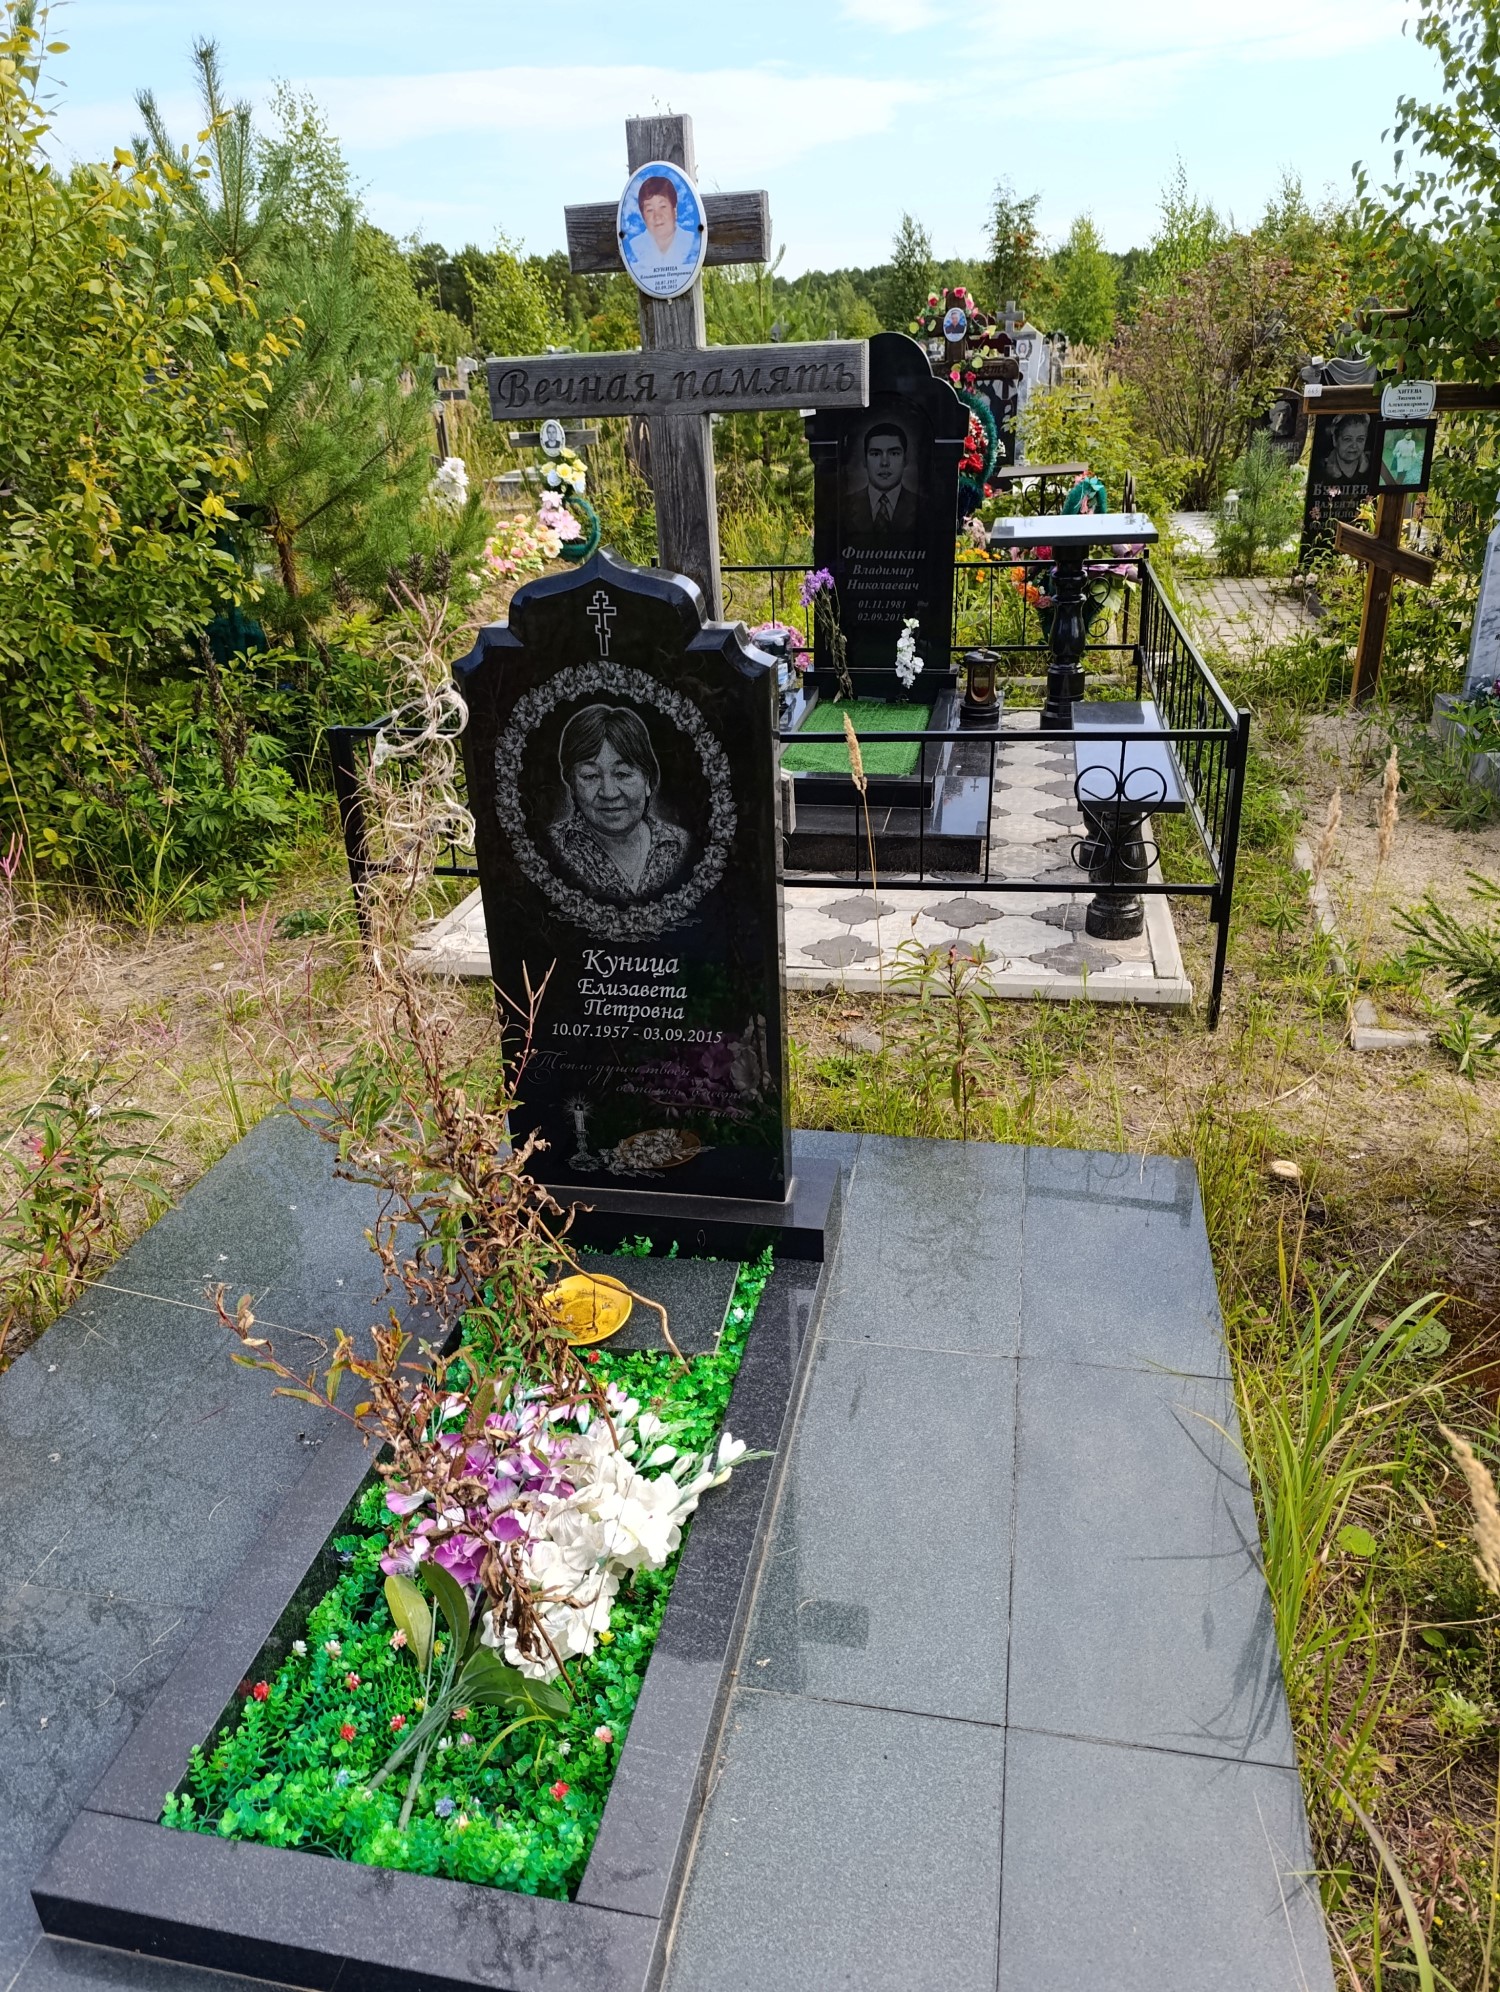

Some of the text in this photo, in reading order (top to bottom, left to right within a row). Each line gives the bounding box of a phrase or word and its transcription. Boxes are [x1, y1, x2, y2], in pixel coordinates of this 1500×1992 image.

[499, 361, 856, 409] Вечная память
[841, 546, 927, 560] Финошкин
[852, 564, 915, 577] Владимир
[846, 579, 920, 591] Николаевич
[858, 600, 907, 609] 01.11.1981
[582, 949, 680, 978] Куница
[577, 978, 687, 999] Елизавета
[583, 999, 685, 1022] Петровна
[551, 1022, 630, 1039] 10.07.1957
[643, 1027, 723, 1044] 03.09.2015
